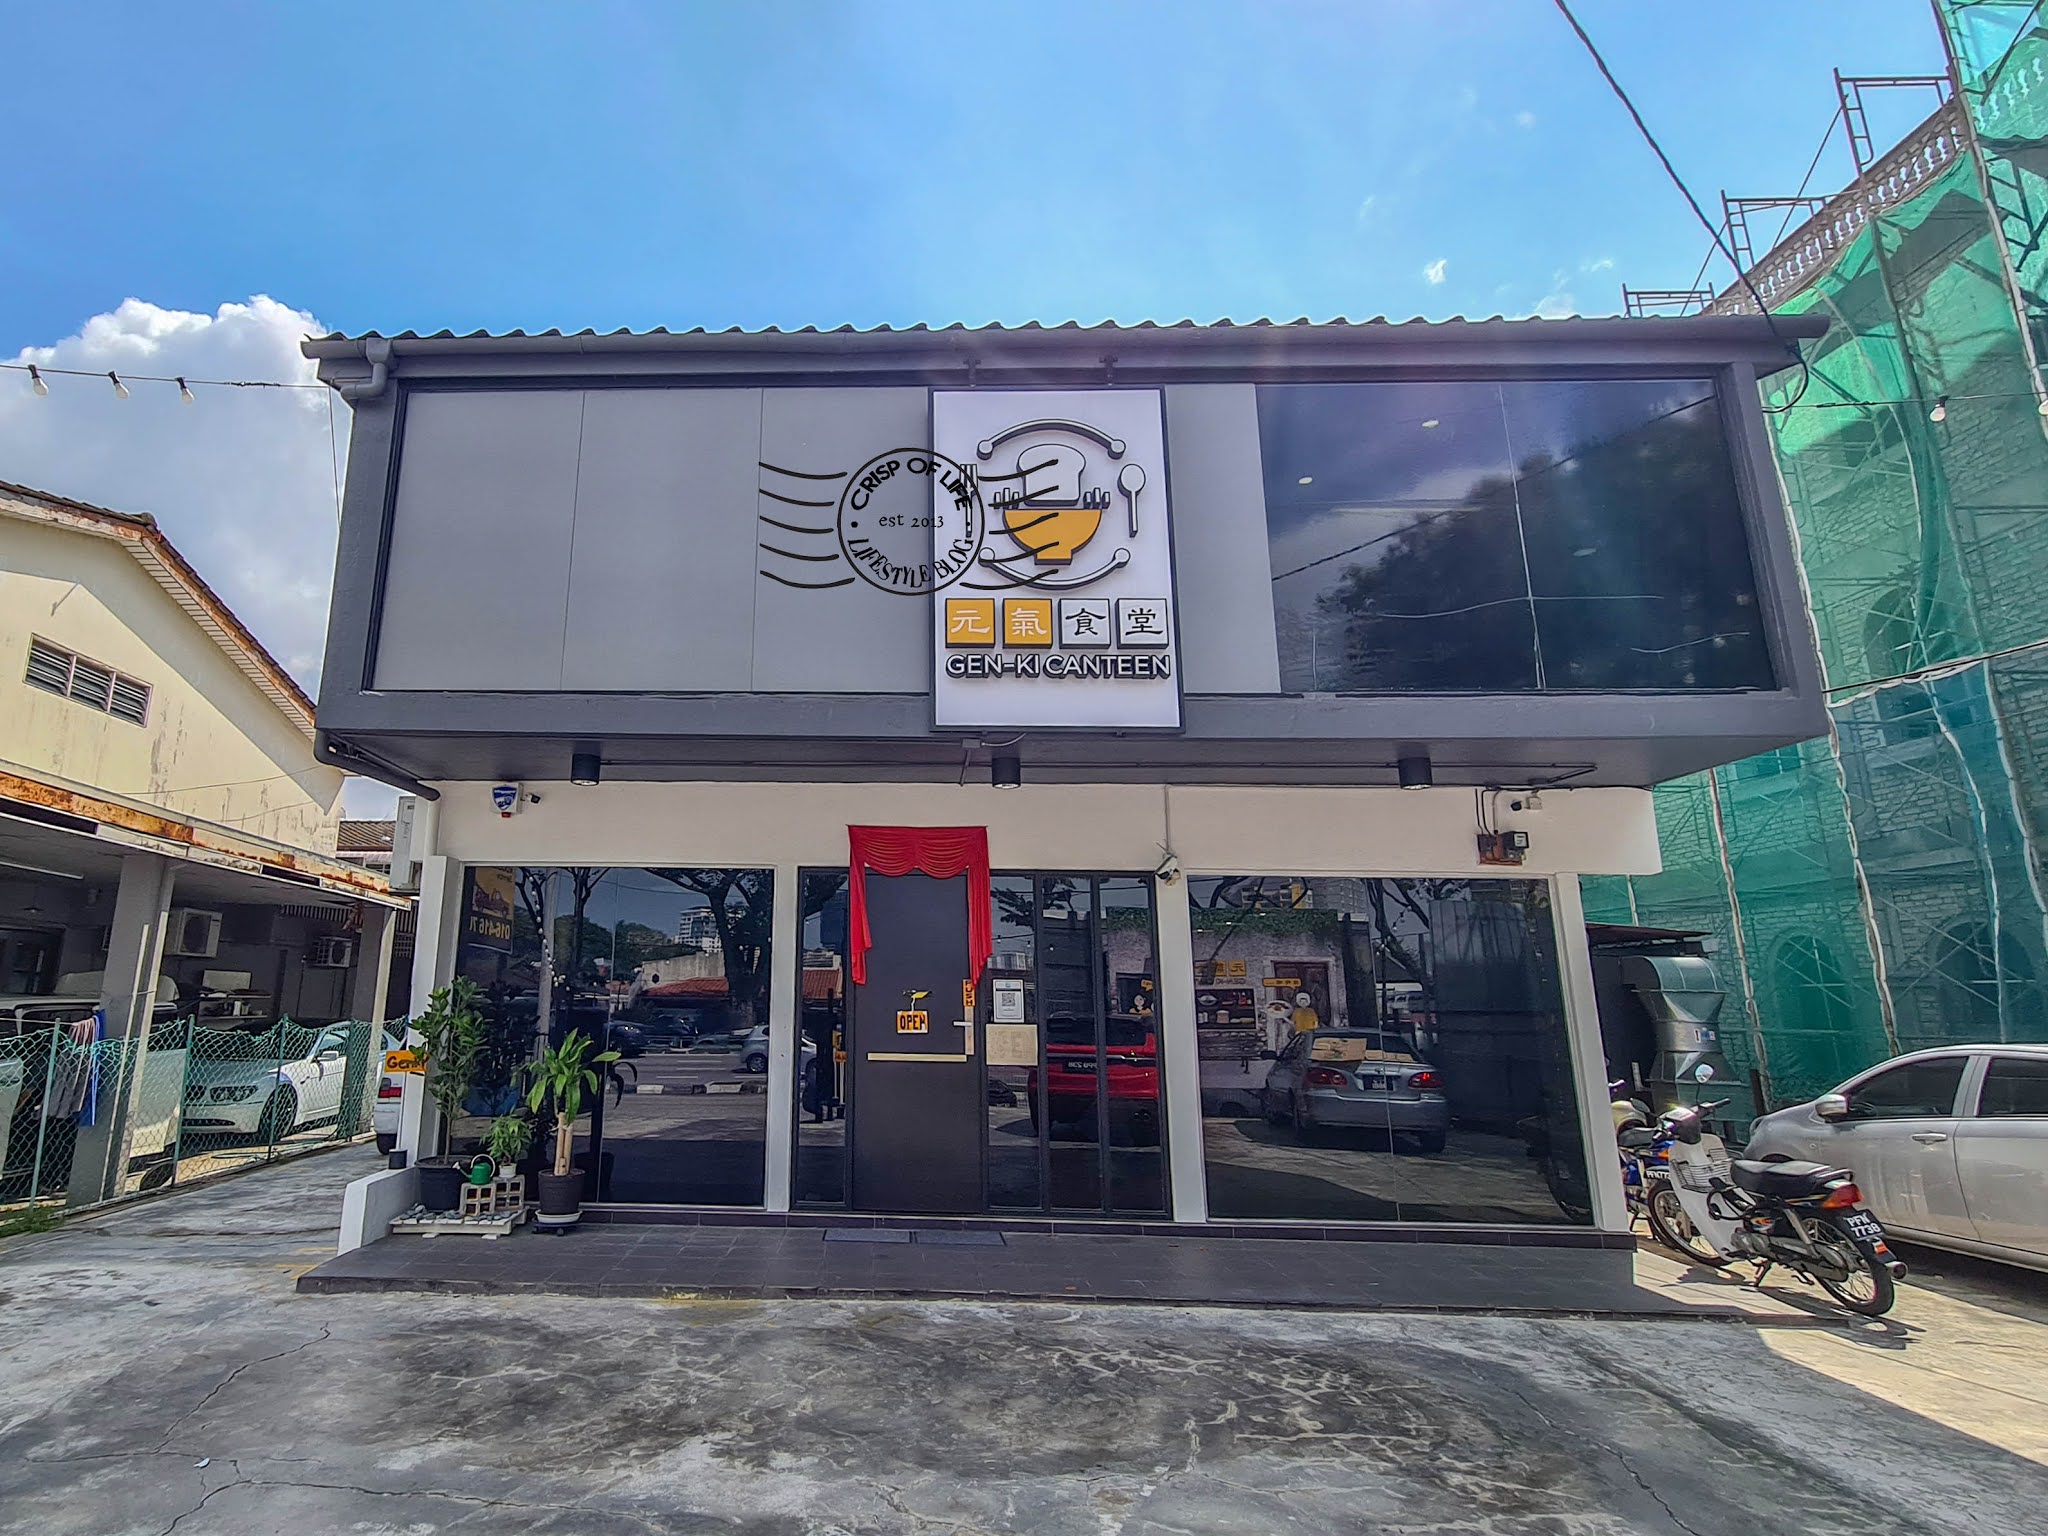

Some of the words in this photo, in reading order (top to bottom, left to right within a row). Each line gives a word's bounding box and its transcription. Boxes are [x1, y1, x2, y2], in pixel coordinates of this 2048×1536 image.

[951, 608, 1163, 637] 元氣食堂
[946, 654, 1040, 678] GEN-KI
[1042, 654, 1170, 679] CANTEEN
[900, 1014, 926, 1031] OPEN
[1846, 1213, 1870, 1227] PFN
[1850, 1222, 1881, 1237] 7738
